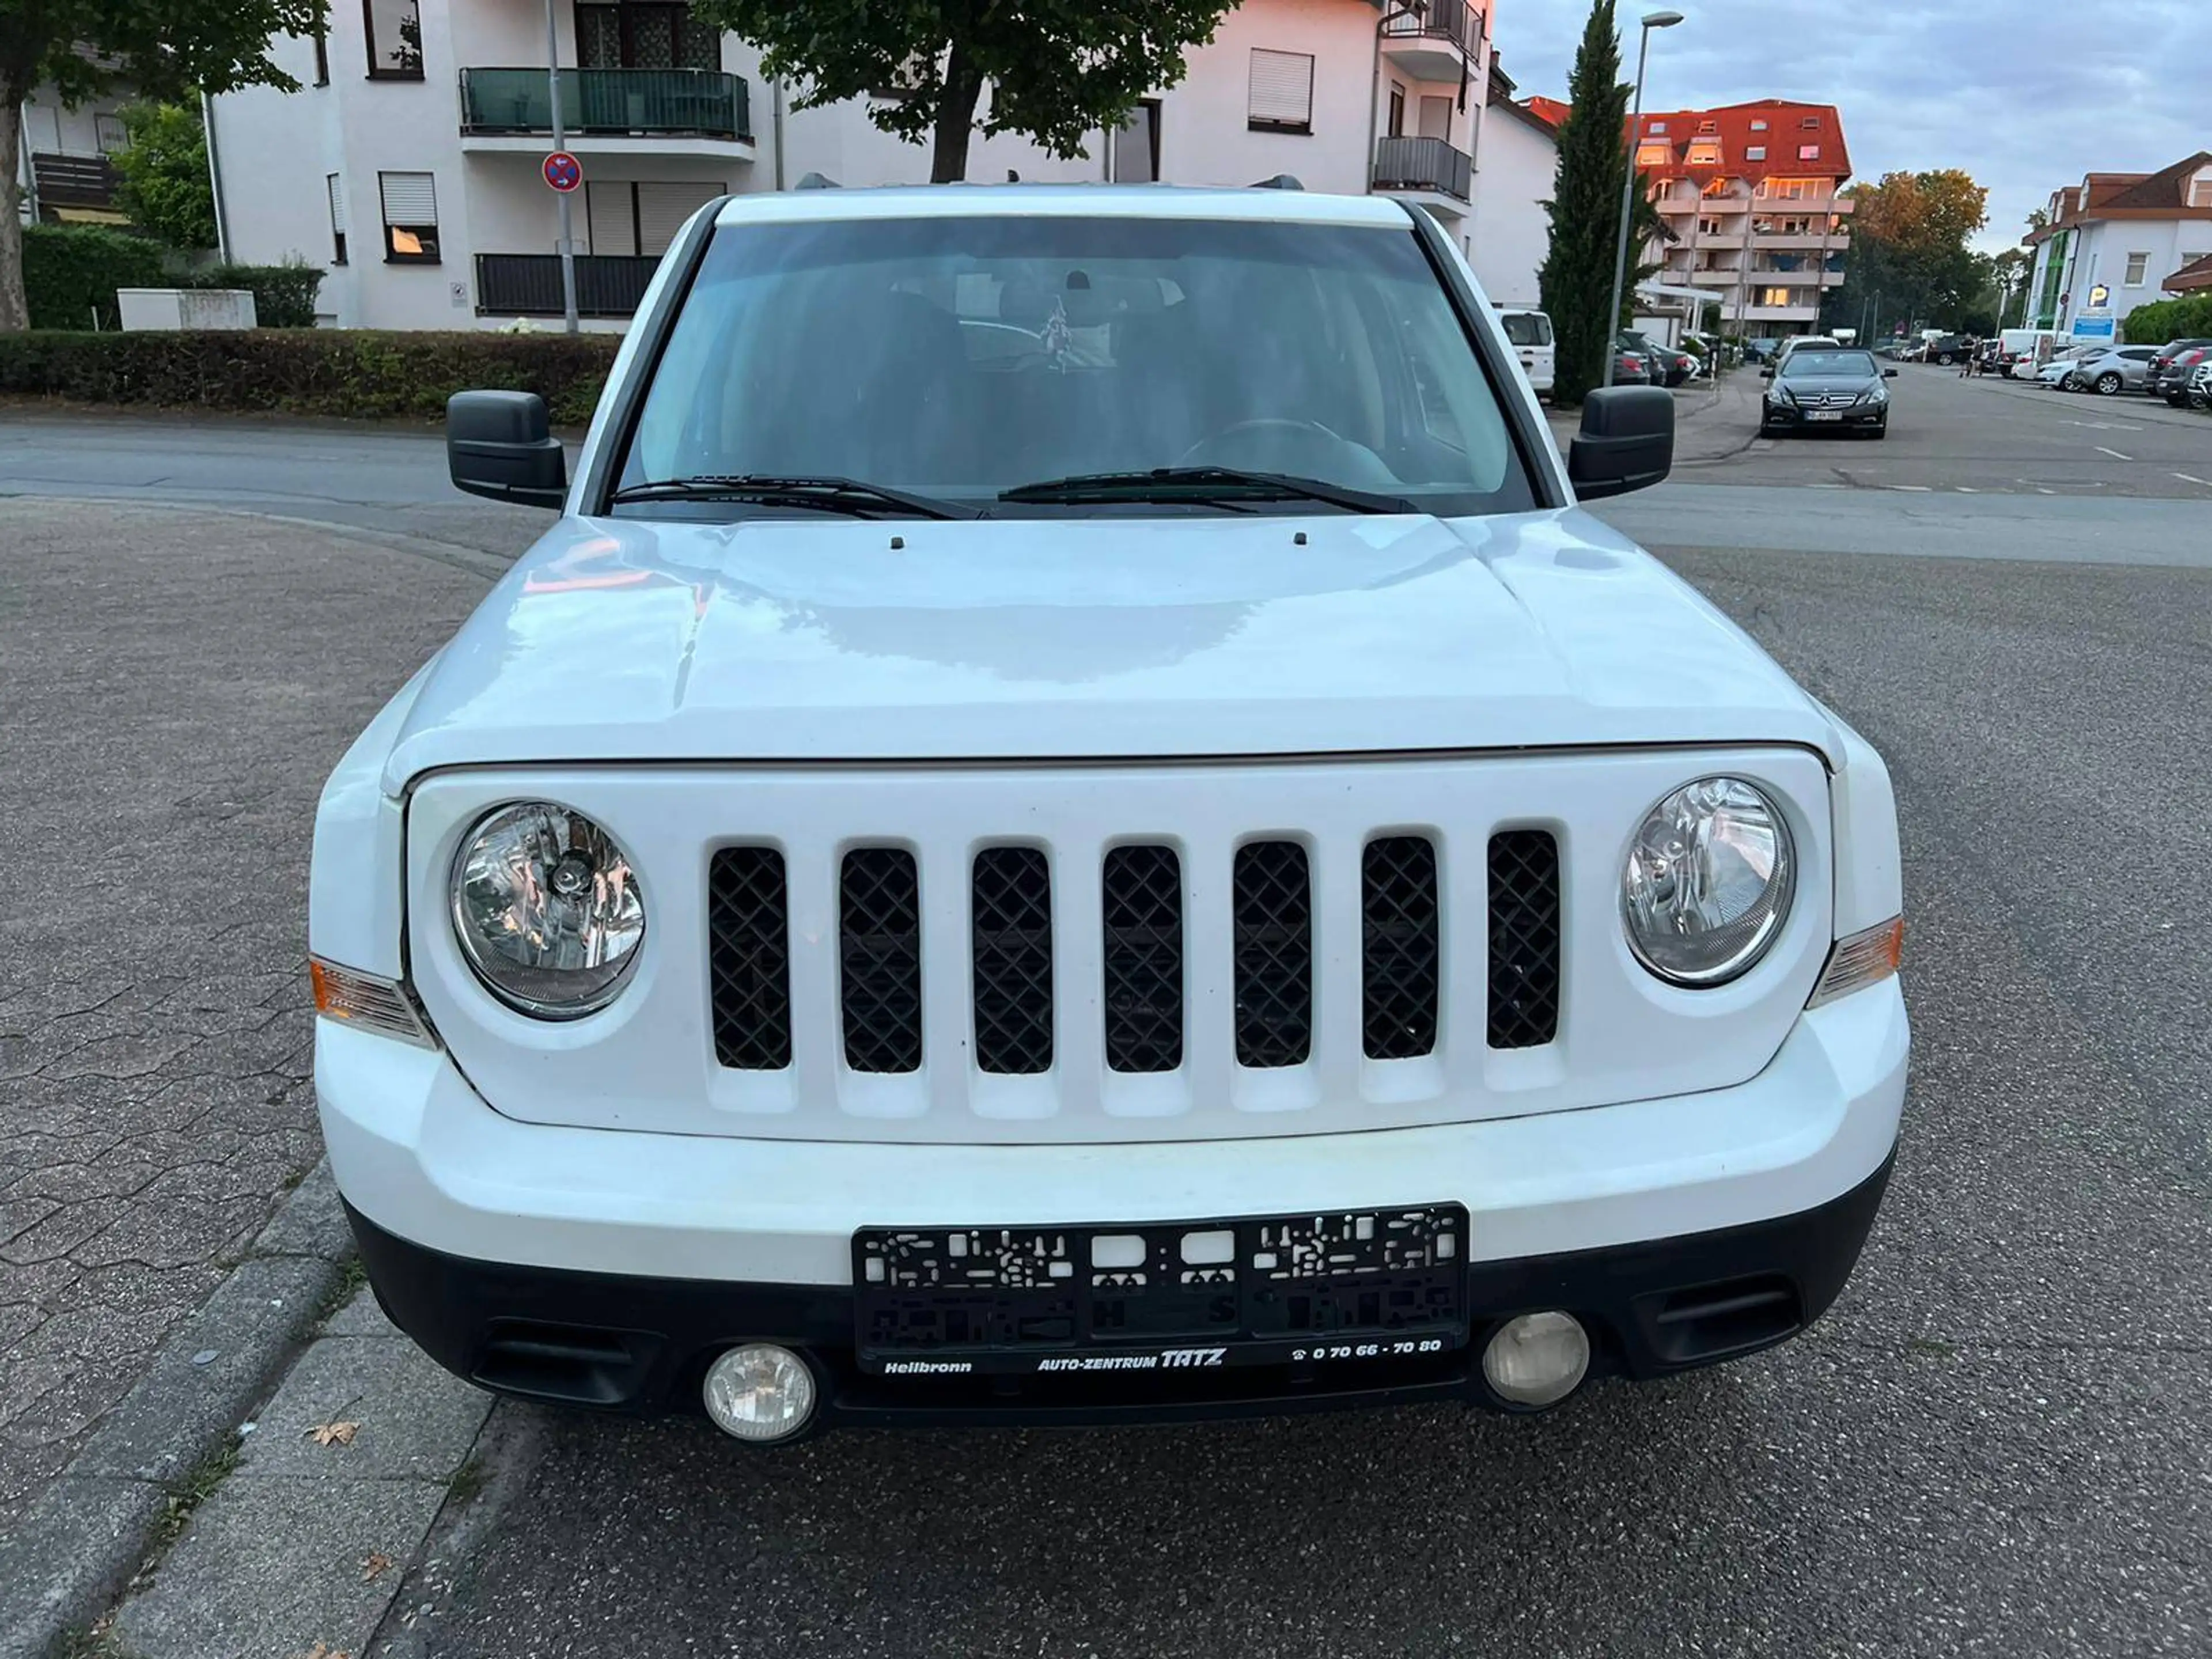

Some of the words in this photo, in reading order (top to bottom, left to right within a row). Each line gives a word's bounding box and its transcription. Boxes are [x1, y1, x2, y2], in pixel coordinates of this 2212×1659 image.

[1313, 1348, 1325, 1359] 0
[1330, 1346, 1351, 1358] 70
[1355, 1344, 1378, 1357] 66
[1393, 1342, 1415, 1354] 70
[1418, 1339, 1441, 1352] 80
[885, 1362, 972, 1374] Heilbronn
[1037, 1356, 1158, 1371] AUTO-ZENTRUM
[1161, 1348, 1228, 1368] TATZ
